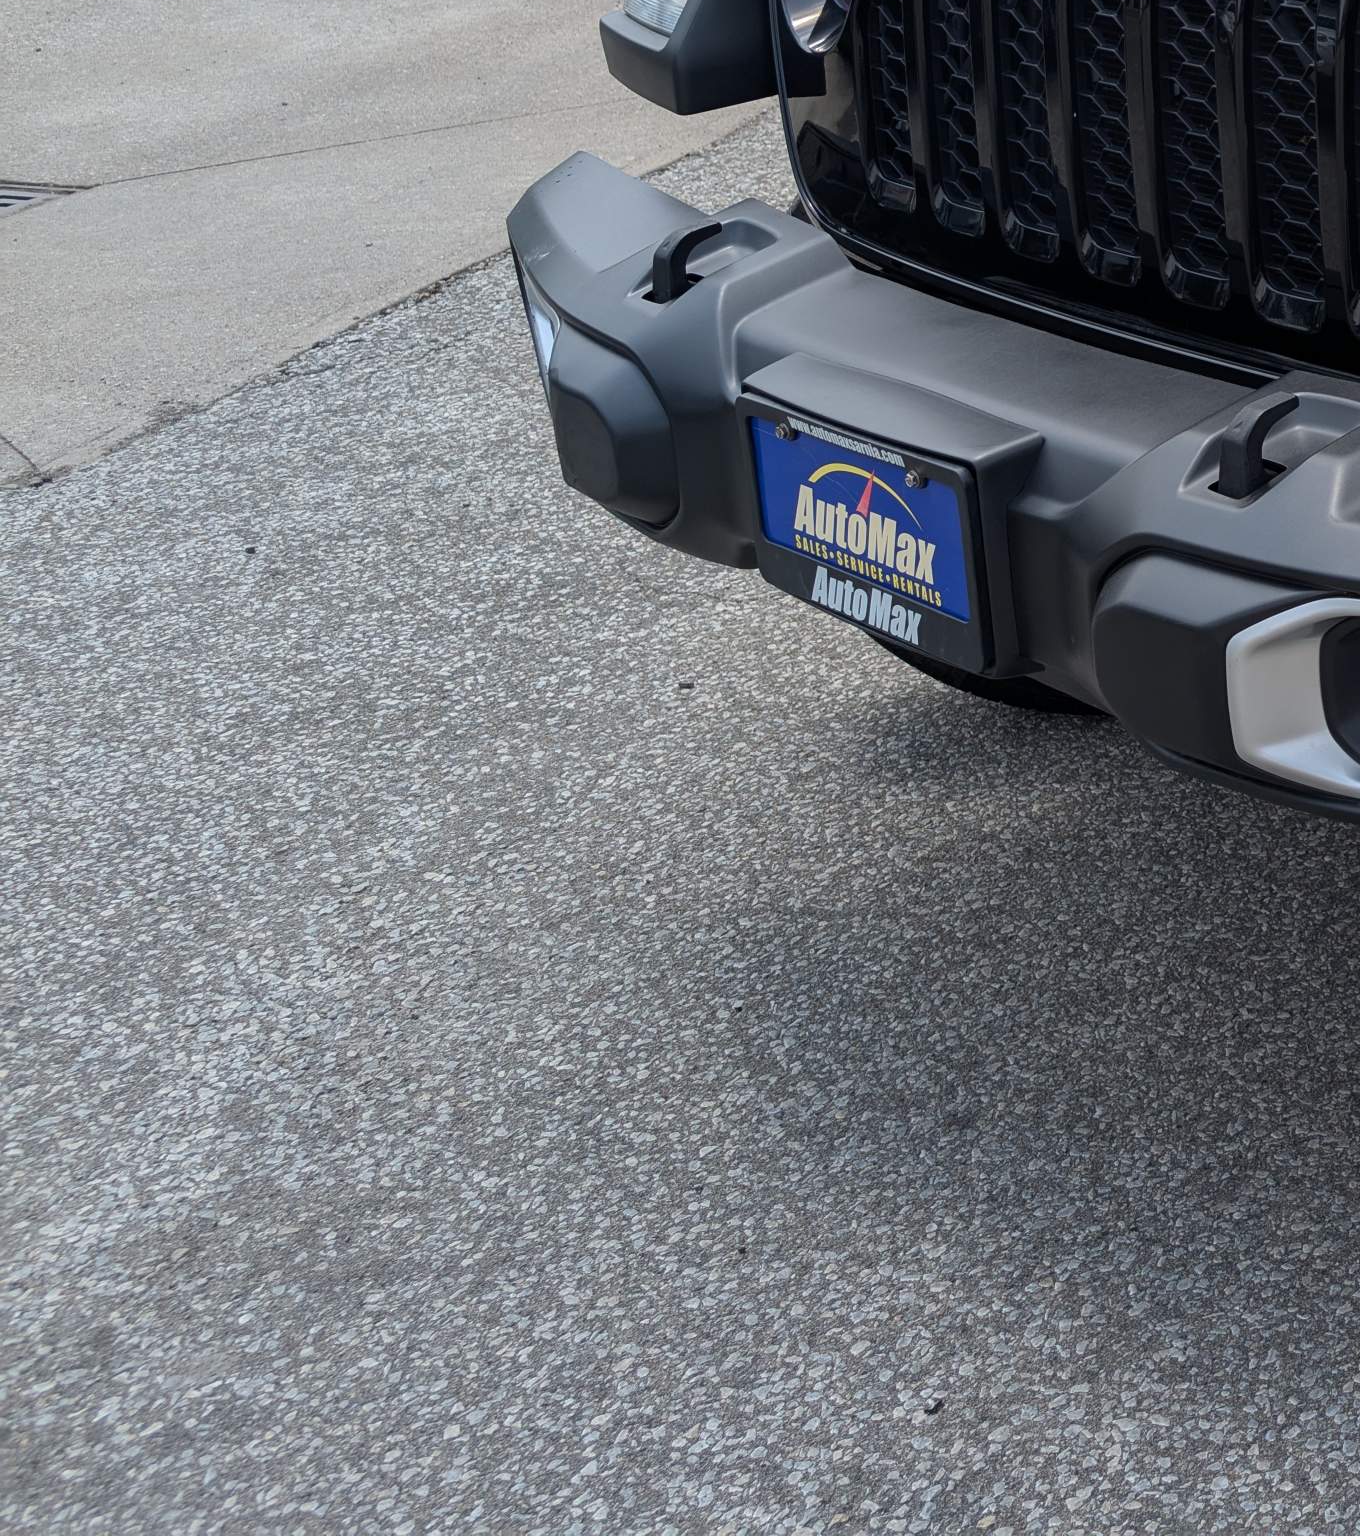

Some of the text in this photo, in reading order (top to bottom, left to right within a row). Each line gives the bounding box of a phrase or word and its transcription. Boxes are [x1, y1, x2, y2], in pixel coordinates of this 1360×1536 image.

[787, 416, 906, 468] www.automaxsarnia.com
[793, 483, 937, 586] AutoMax
[795, 534, 942, 608] SALES SERVICE RENTALS
[811, 565, 922, 646] AutoMax
